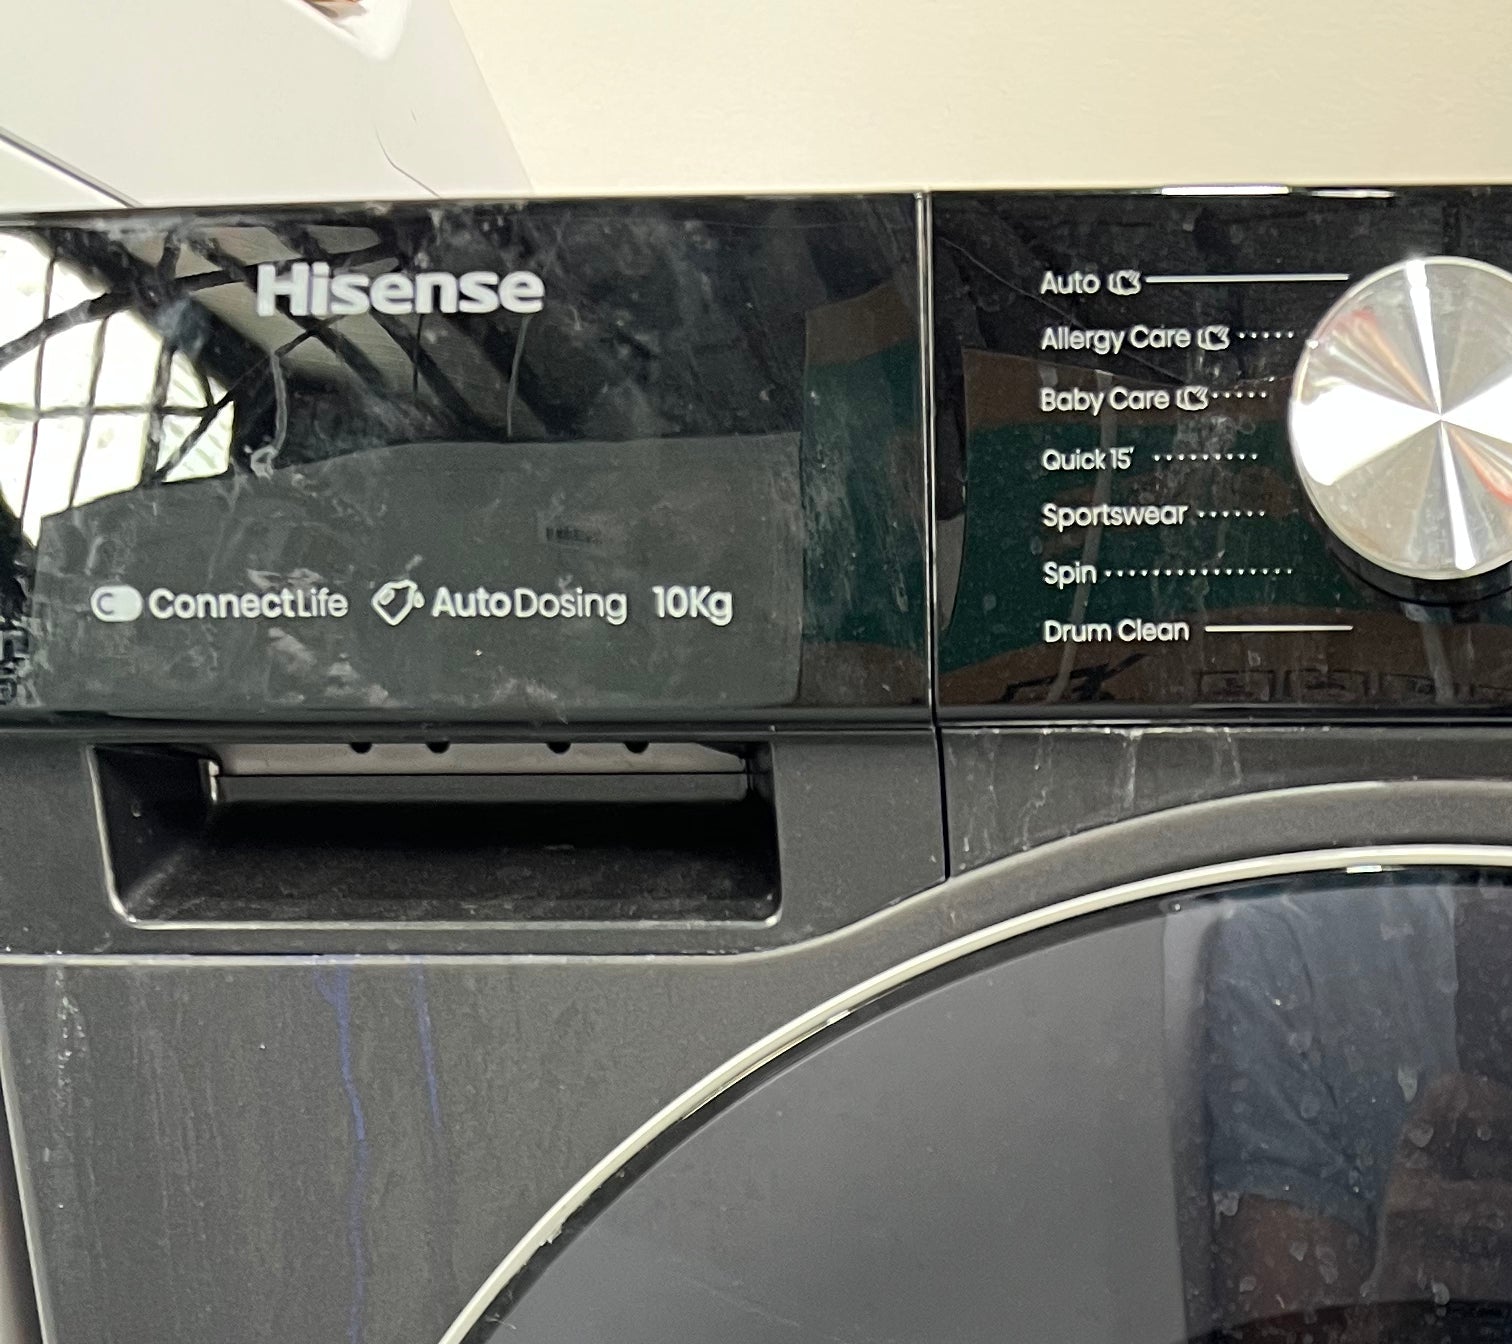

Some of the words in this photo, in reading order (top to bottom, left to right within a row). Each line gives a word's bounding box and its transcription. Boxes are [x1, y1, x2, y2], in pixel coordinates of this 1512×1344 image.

[257, 261, 546, 317] Hisense
[1040, 271, 1100, 295] Auto
[1041, 327, 1125, 354] Allergy
[1129, 325, 1191, 349] Care
[1040, 387, 1104, 416] Baby
[1108, 386, 1170, 410] Care
[1042, 449, 1106, 471] Quick
[1041, 504, 1189, 532] Sportswear
[1042, 561, 1097, 589] Spin
[150, 587, 348, 619] ConnectLife
[652, 585, 732, 626] 10Kg
[1043, 619, 1112, 643] Drum
[1117, 618, 1190, 642] Clean
